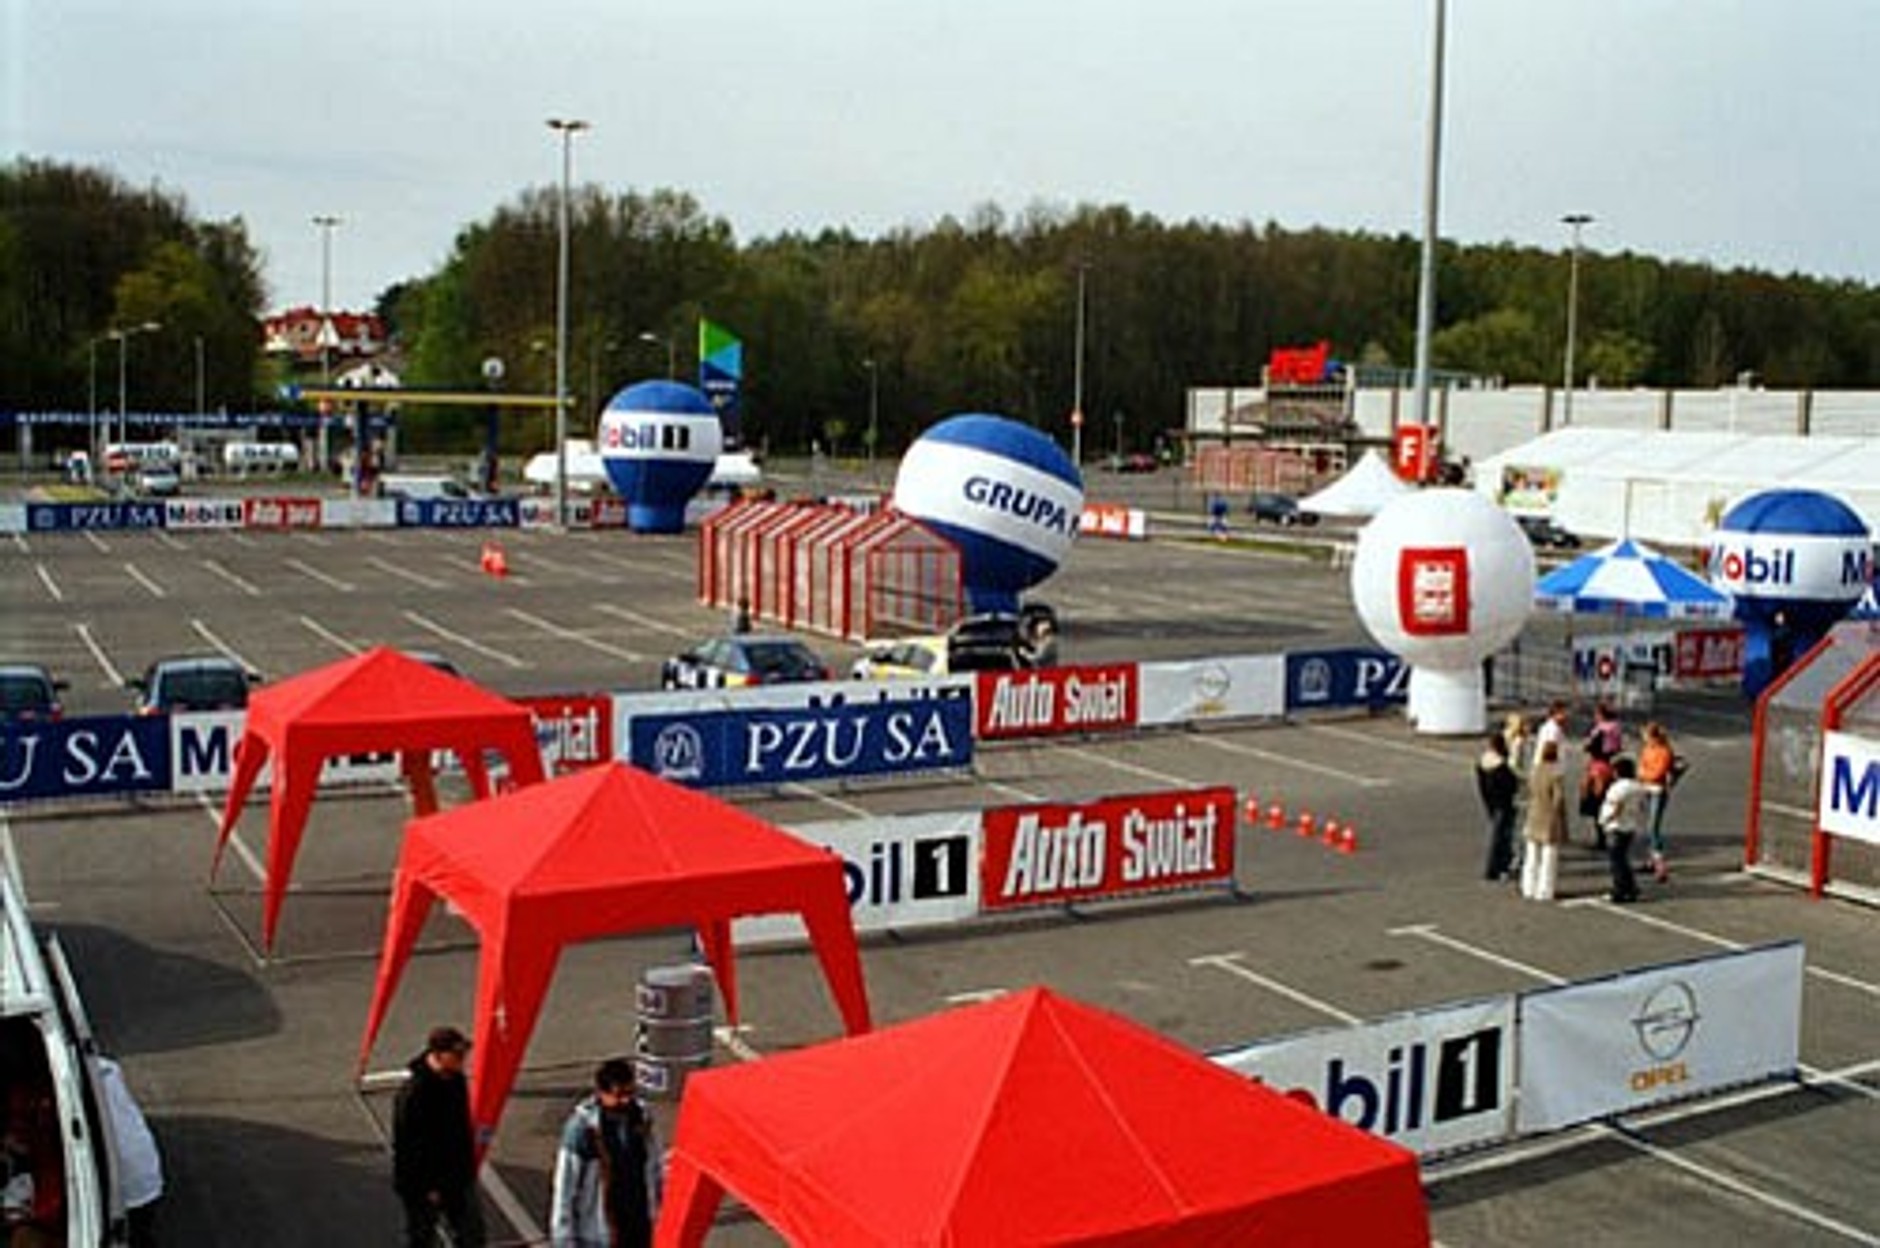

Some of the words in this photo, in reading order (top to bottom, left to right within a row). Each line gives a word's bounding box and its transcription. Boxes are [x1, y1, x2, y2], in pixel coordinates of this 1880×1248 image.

[604, 424, 656, 450] obil
[1401, 437, 1418, 466] F
[963, 477, 1068, 532] GRUPA
[989, 674, 1055, 728] Auto
[64, 729, 152, 786] SA
[745, 716, 870, 772] PZU
[883, 711, 952, 760] SA
[1002, 814, 1107, 898] Auto
[1629, 1063, 1688, 1092] OPEL
